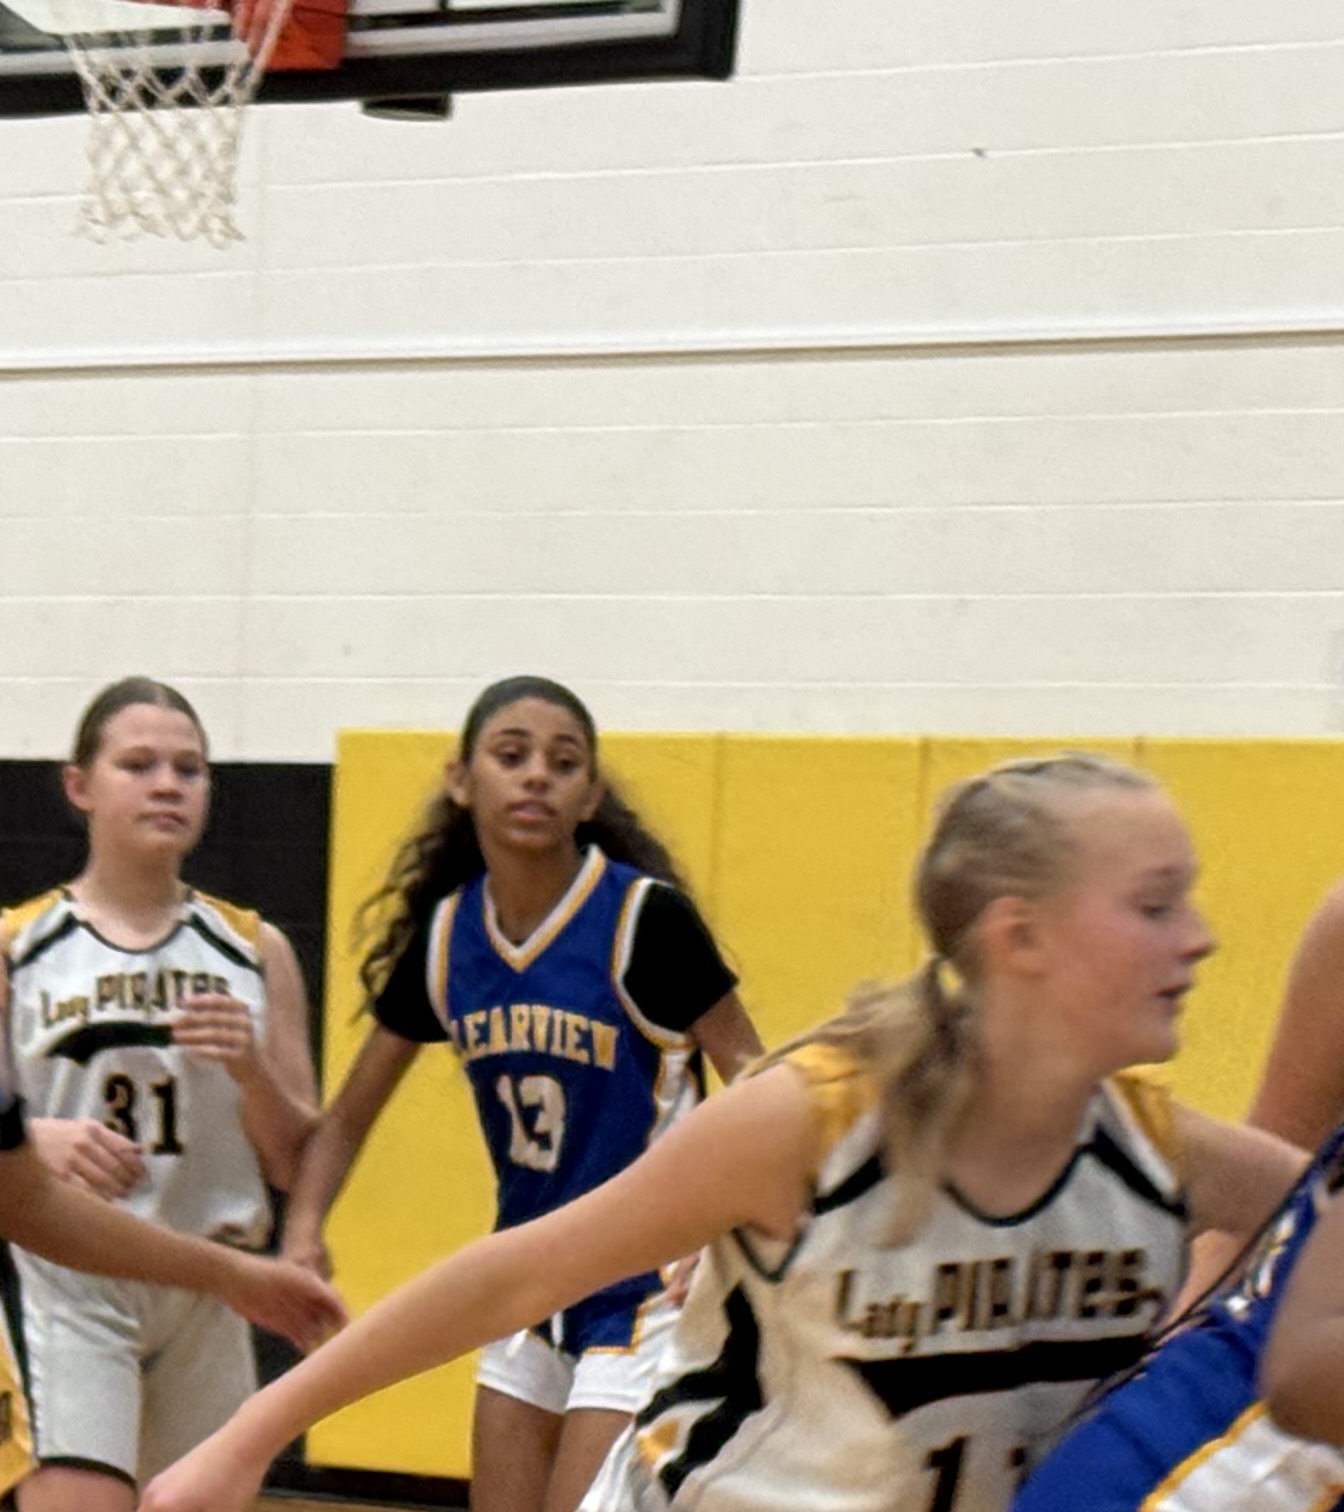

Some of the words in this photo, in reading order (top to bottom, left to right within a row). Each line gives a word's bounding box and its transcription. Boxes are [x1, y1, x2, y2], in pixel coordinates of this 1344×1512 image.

[450, 1003, 620, 1072] LEARVIEW
[103, 1072, 185, 1155] 31
[495, 1073, 567, 1173] 13
[929, 1249, 1154, 1332] PIRATES
